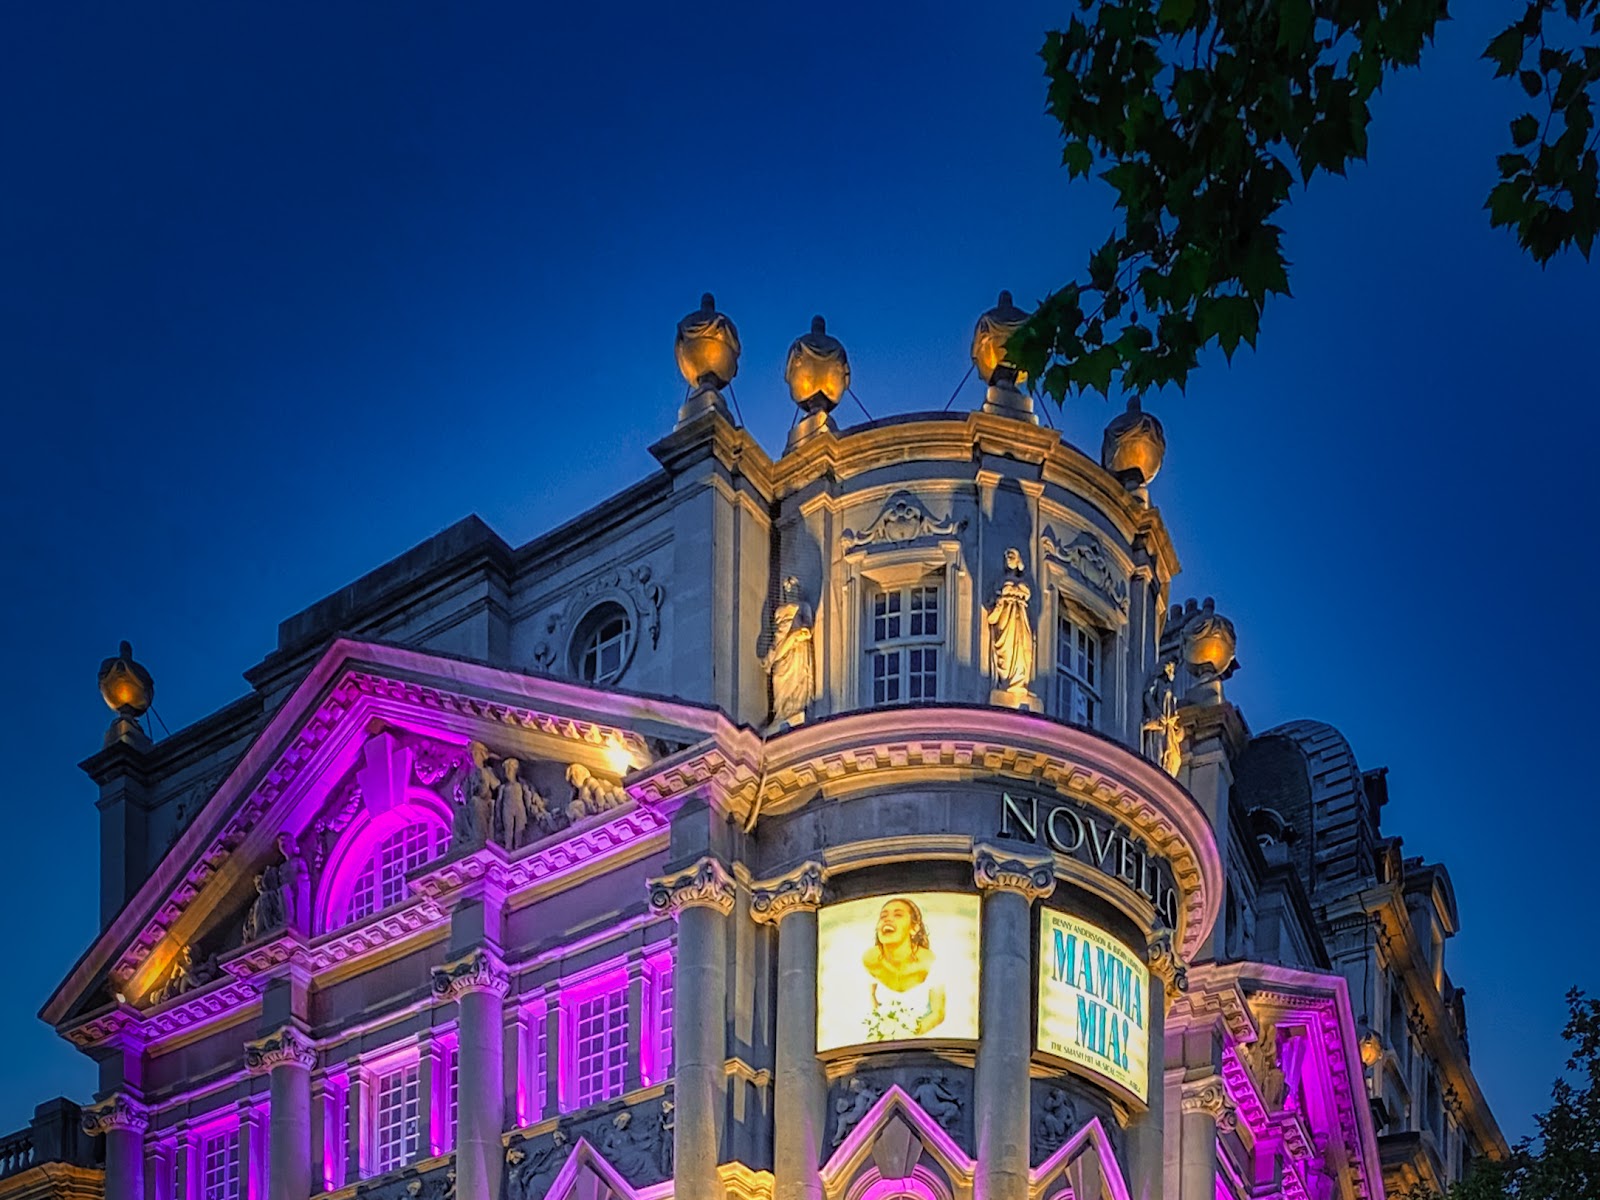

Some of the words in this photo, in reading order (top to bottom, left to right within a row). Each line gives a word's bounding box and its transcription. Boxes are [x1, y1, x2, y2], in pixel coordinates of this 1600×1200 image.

[998, 791, 1178, 931] NOVELLO
[1051, 928, 1143, 1030] MAMMA
[1063, 1047, 1084, 1059] SMASH
[1074, 993, 1130, 1072] MIA!
